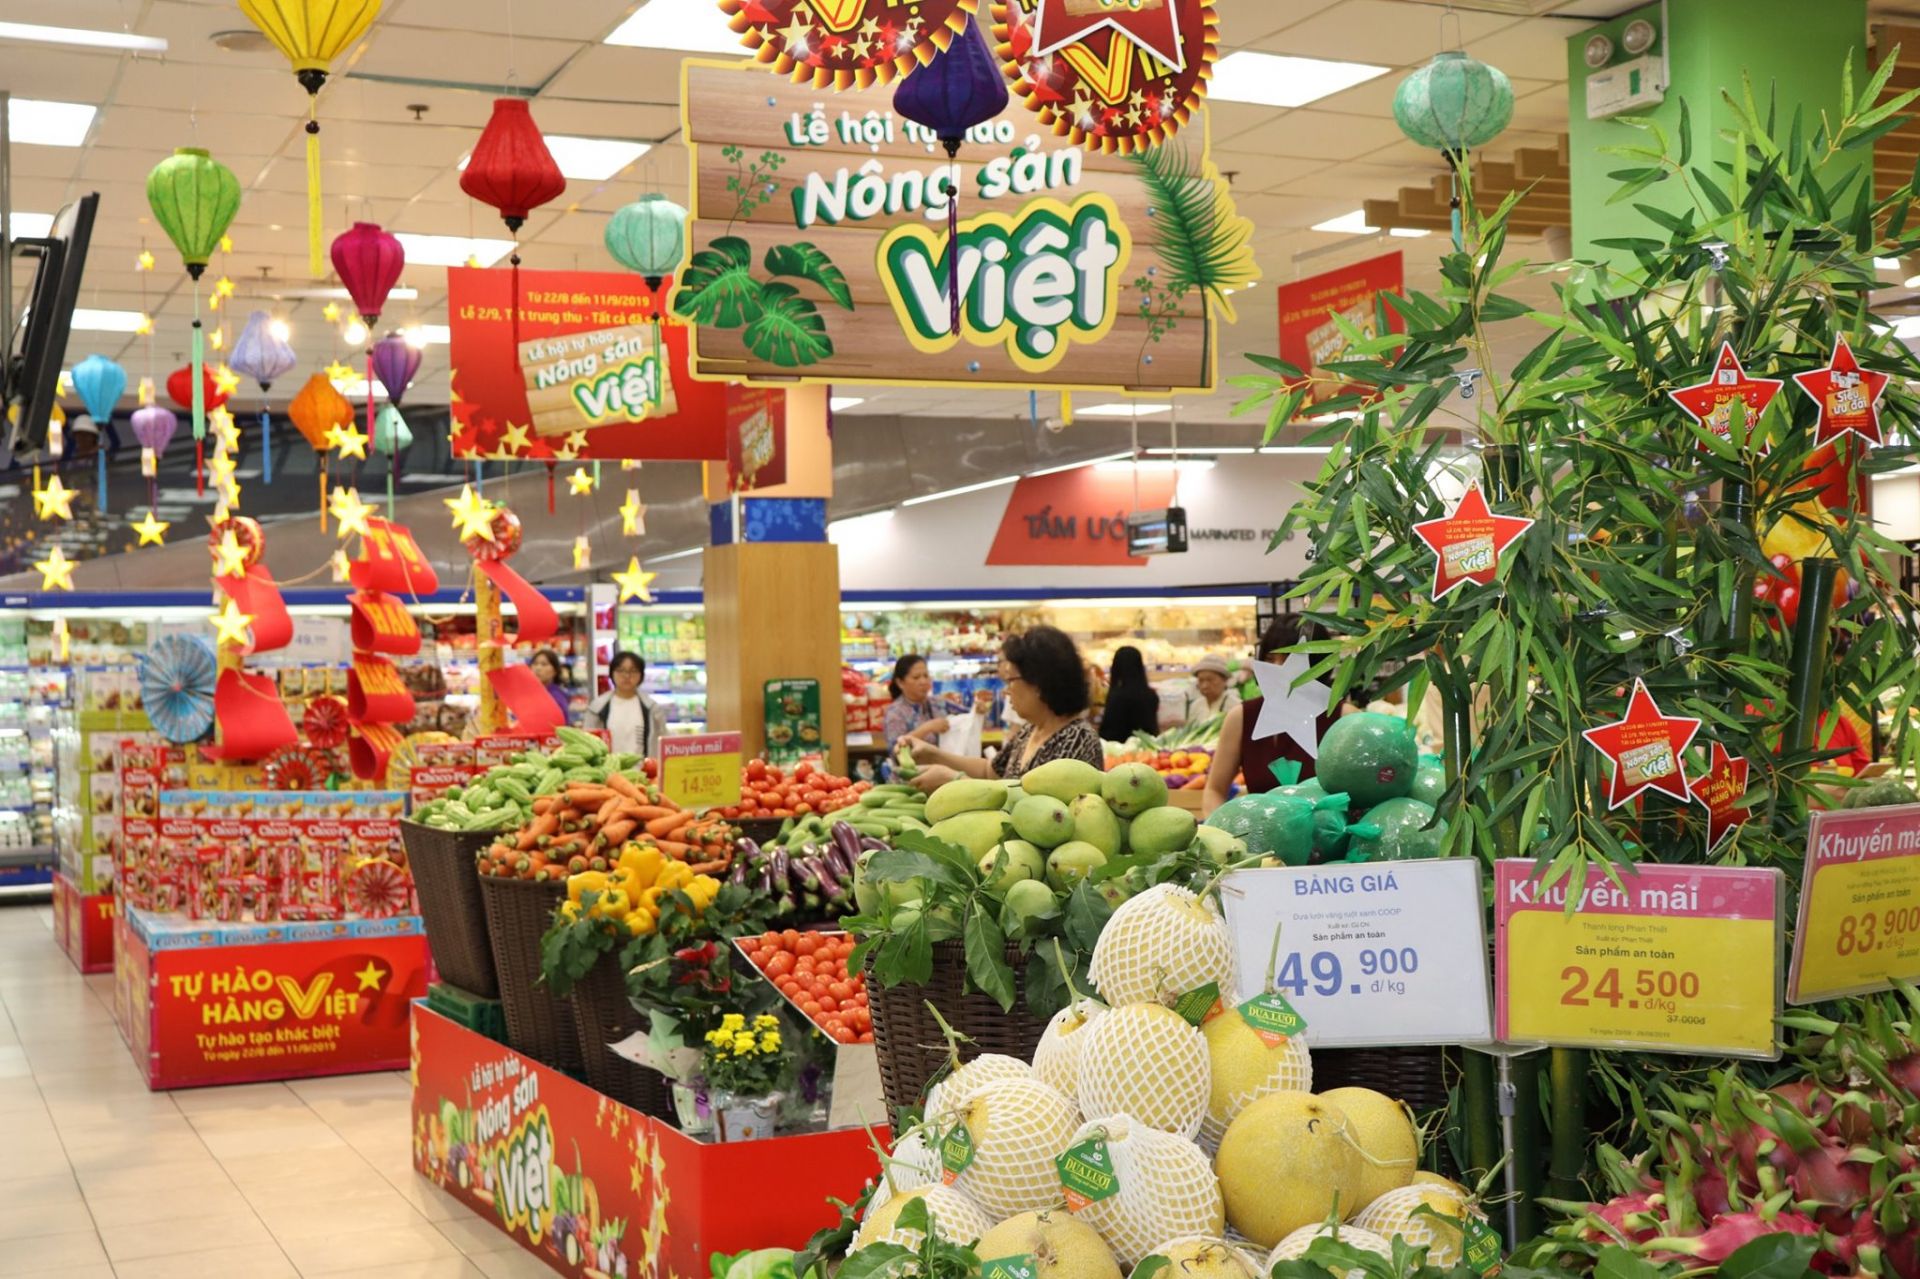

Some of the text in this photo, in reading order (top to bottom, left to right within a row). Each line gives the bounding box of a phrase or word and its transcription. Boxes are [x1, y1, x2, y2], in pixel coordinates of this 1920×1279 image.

[788, 102, 830, 146] Lễ
[838, 110, 895, 153] hội
[797, 134, 1083, 227] Nông sản
[593, 294, 650, 307] 11/9/2019
[898, 217, 1119, 355] Việt
[460, 304, 475, 320] Lễ
[505, 307, 525, 321] Tt
[527, 311, 559, 325] trung
[562, 312, 582, 323] thu
[536, 335, 643, 390] Nông sản
[548, 340, 569, 357] hội
[577, 359, 656, 416] Việt
[1088, 509, 1129, 540] ƯỚ
[1190, 529, 1256, 541] MARINATED
[1817, 823, 1893, 861] Khuyến
[1294, 871, 1399, 896] BẢNG GIÁ
[1639, 884, 1698, 911] mãi
[1367, 931, 1386, 939] toàn
[1633, 950, 1647, 958] an
[1650, 949, 1675, 959] toàn
[169, 966, 273, 1002] TỰ HÀO
[202, 973, 360, 1025] HÀNG VIỆT
[196, 1025, 341, 1050] Tự hào tạo khác biệt
[477, 1065, 539, 1146] Nông sản
[500, 1121, 552, 1230] Việt
